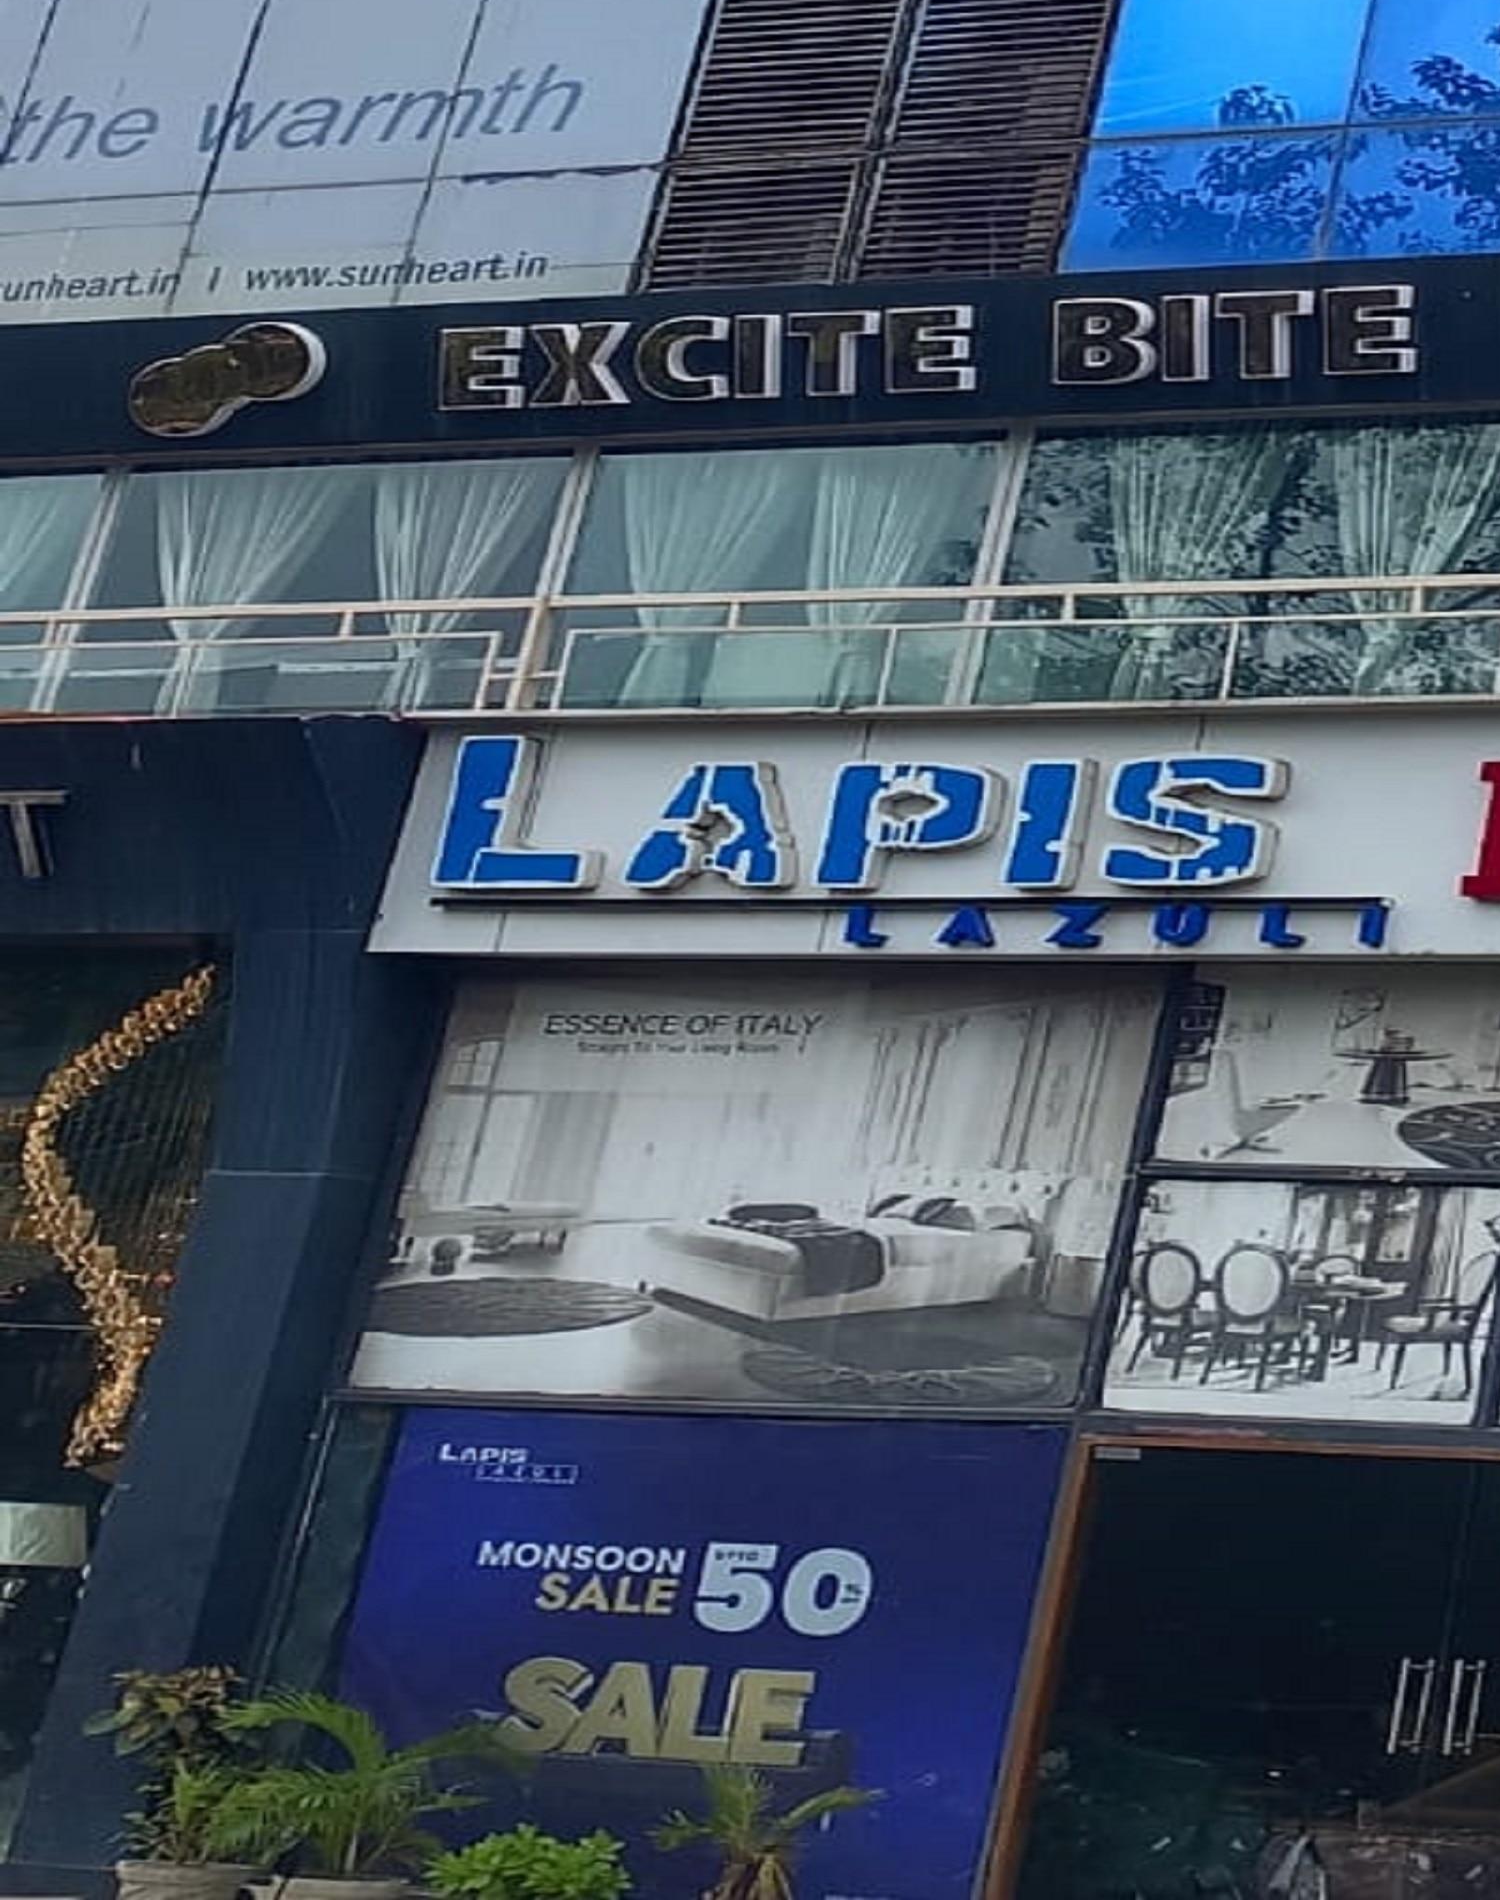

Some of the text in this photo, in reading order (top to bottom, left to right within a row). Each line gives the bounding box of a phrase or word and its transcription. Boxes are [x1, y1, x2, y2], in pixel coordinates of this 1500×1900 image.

[0, 62, 585, 165] the warmth
[245, 251, 549, 292] www.sunheart.in
[438, 284, 1420, 412] EXCITE BITE
[430, 733, 1292, 897] LAPIS
[844, 900, 1392, 949] LAZULI
[544, 1014, 823, 1038] ESSENCE OF ITALY
[477, 1540, 687, 1575] MONSOON
[534, 1571, 682, 1616] SALE
[502, 1655, 816, 1766] SALE
